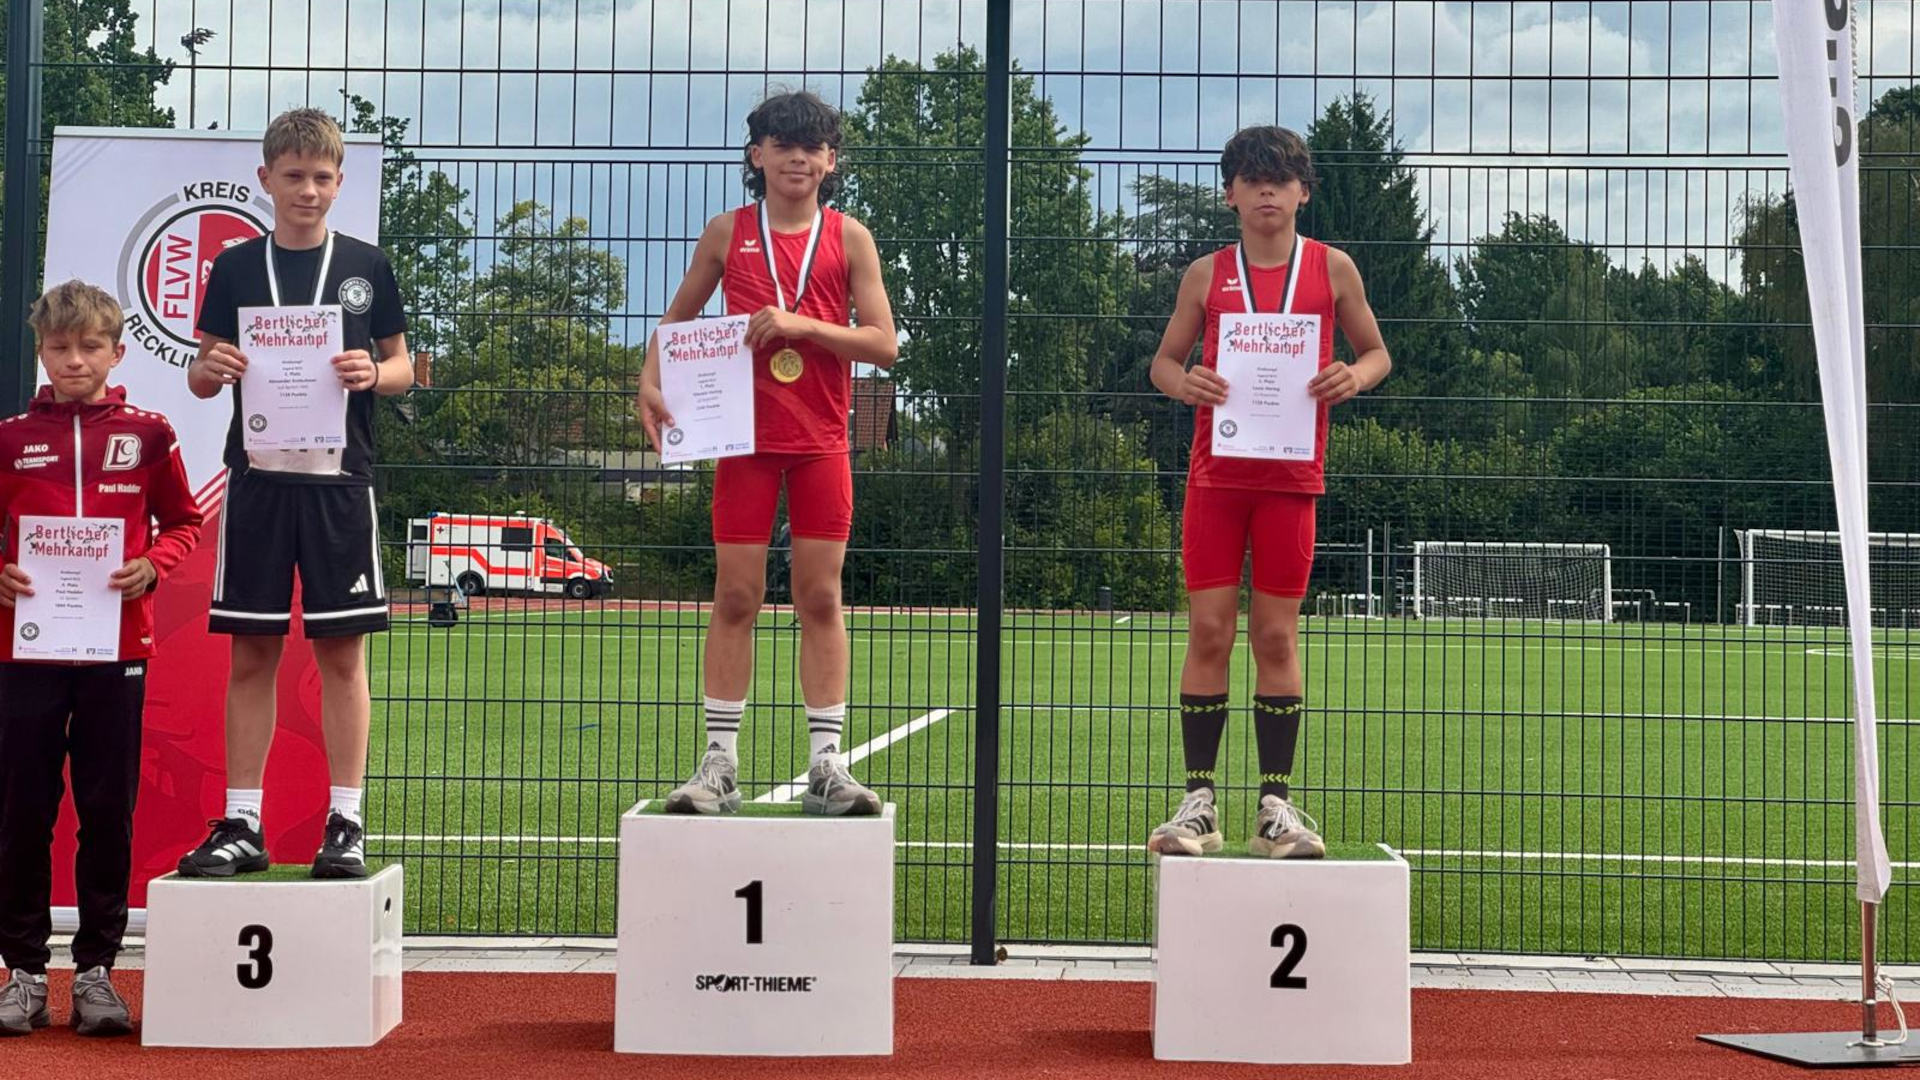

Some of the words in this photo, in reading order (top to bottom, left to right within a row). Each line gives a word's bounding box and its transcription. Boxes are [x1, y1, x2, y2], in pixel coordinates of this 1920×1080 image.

[183, 181, 250, 203] KREIS
[163, 234, 193, 320] FLVW
[254, 314, 328, 330] Bertlicher
[1234, 322, 1306, 337] Bertlicher
[254, 332, 328, 349] Mehrkampf
[671, 326, 738, 346] Bertlicher
[672, 343, 740, 363] Mehrkampf
[1233, 340, 1307, 358] Mehrkampf
[23, 444, 48, 454] JAKO
[98, 483, 116, 493] Paul
[35, 525, 109, 540] Bertlicher
[35, 542, 109, 560] Mehrkampf
[735, 880, 763, 944] 1
[237, 924, 273, 989] 3
[1270, 923, 1308, 989] 2
